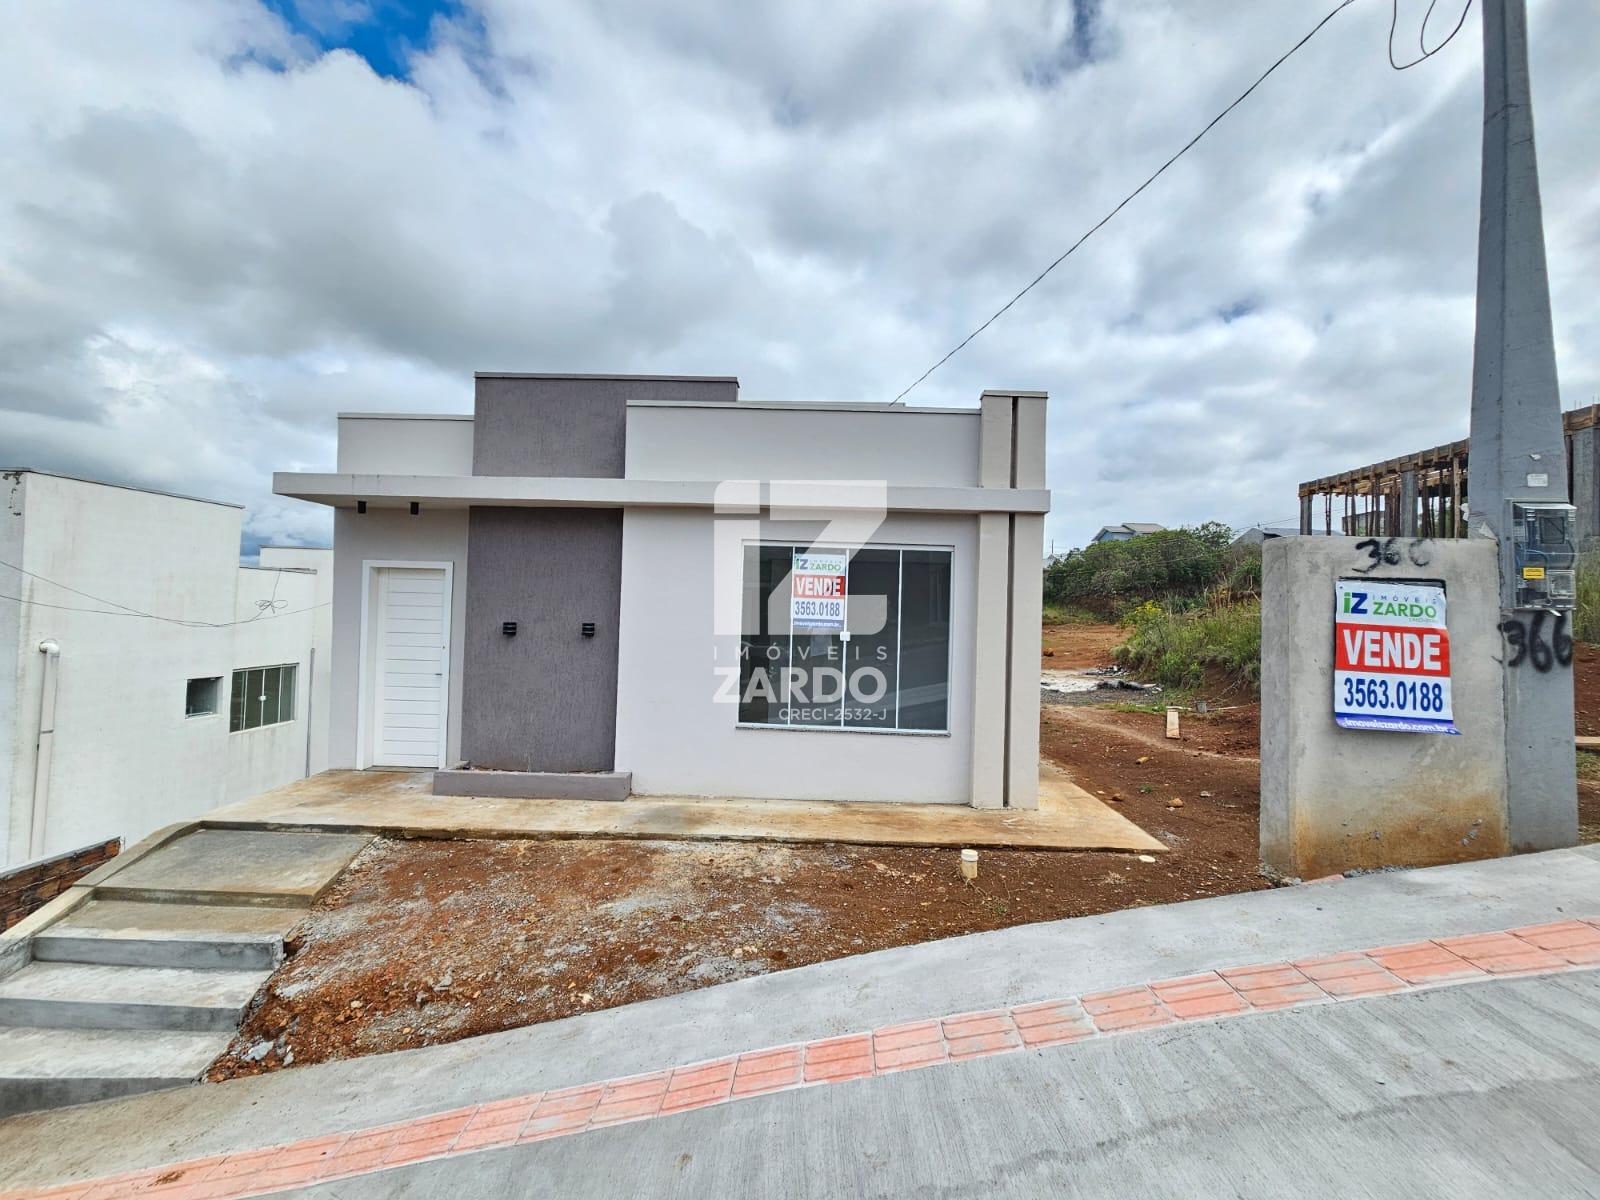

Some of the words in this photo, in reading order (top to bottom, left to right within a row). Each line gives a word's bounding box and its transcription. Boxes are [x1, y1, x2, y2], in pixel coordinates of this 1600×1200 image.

[810, 563, 841, 571] ZARDO
[796, 577, 841, 597] VENDE
[795, 601, 841, 616] 3563.0188
[1372, 601, 1437, 619] ZARDO
[1343, 629, 1442, 671] VENDE
[1492, 609, 1573, 673] 366
[1343, 677, 1443, 712] 3563.0188
